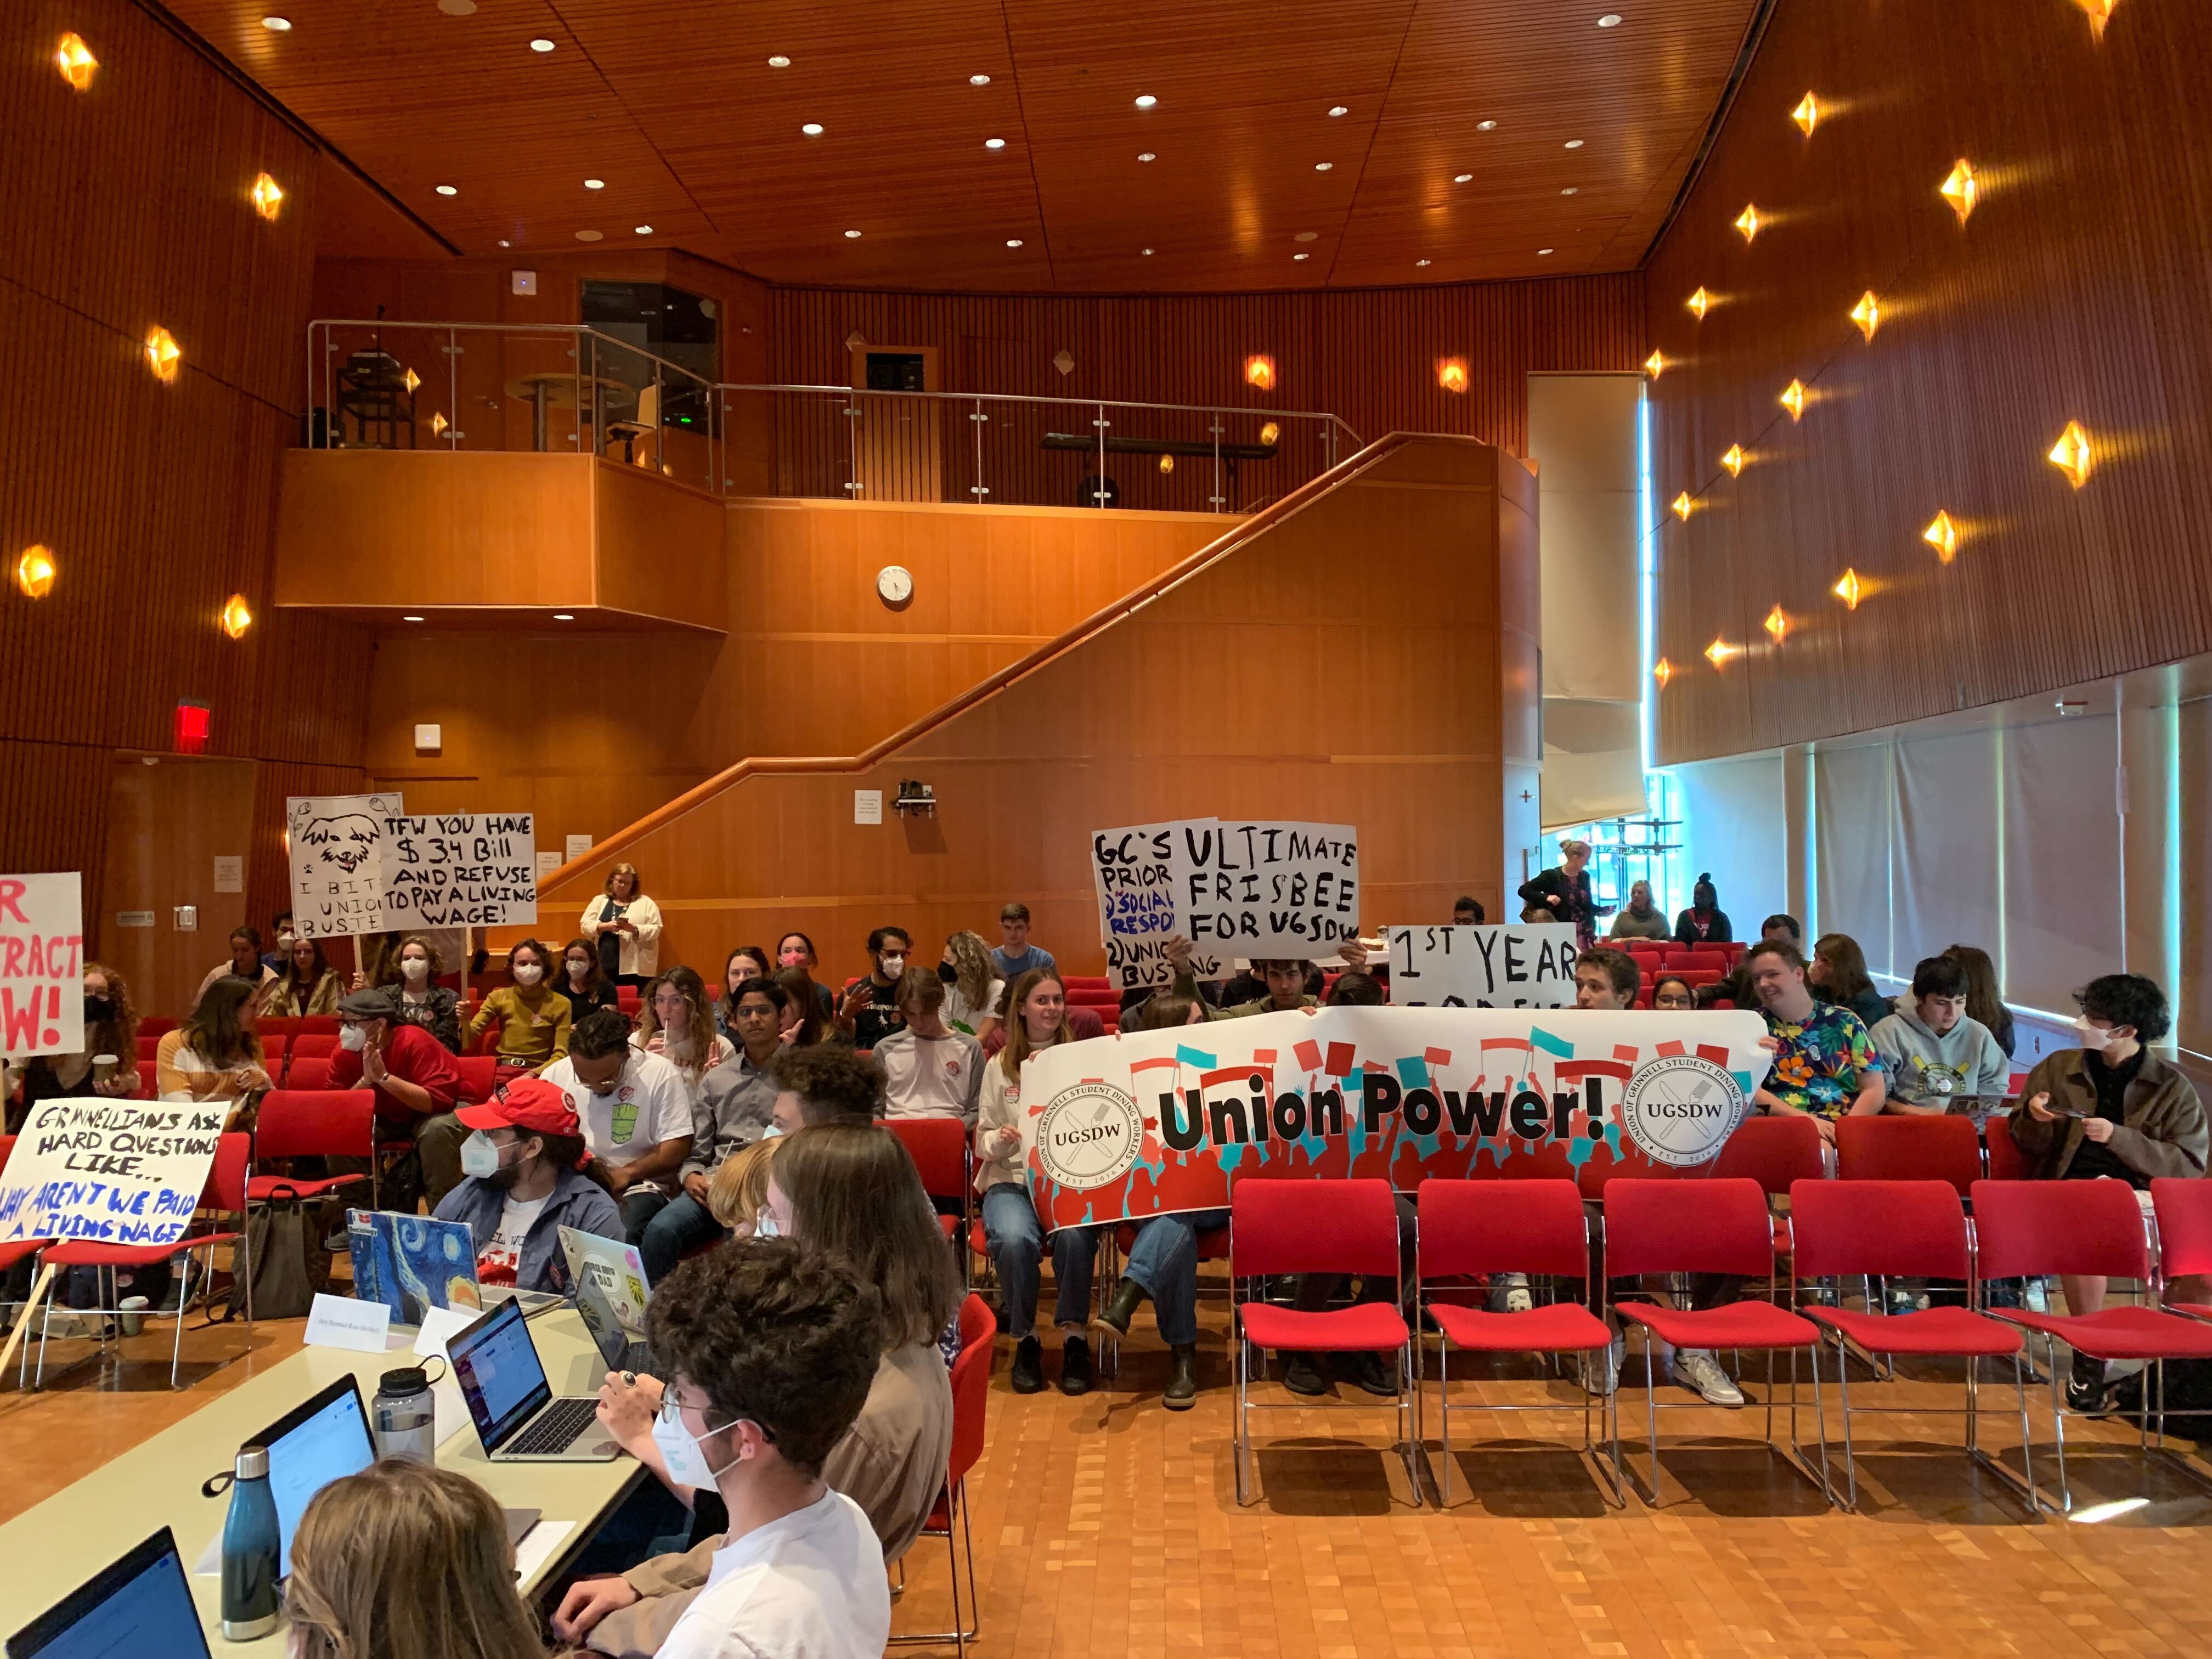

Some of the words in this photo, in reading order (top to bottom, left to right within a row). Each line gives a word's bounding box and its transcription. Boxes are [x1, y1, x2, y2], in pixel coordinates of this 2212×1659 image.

[383, 817, 426, 835] TFW
[436, 816, 474, 835] YOU
[486, 816, 531, 835] HAVE
[473, 836, 511, 862] Bill
[1095, 830, 1172, 865] GC'S
[1185, 826, 1357, 870] ULTIMATE
[299, 882, 312, 895] I
[328, 877, 382, 895] BIT
[393, 868, 448, 885] AND
[453, 866, 532, 884] REFUSE
[385, 889, 409, 910] TO
[411, 886, 443, 909] PAY
[448, 888, 463, 903] A
[467, 885, 536, 903] LIVING
[1189, 871, 1355, 912] FRISBEE
[420, 904, 507, 926] WAGE!
[1110, 911, 1175, 935] RESPO
[1189, 912, 1260, 941] FOR
[0, 934, 83, 979] RACT
[1474, 930, 1577, 994] YEAR
[0, 985, 60, 1052] W!
[1666, 1059, 1714, 1071] STUDENT
[1070, 1086, 1111, 1097] STUDENT
[1628, 1063, 1664, 1098] GRINNELL
[1714, 1069, 1741, 1099] DINING
[1041, 1095, 1069, 1132] GRINNELL
[1111, 1091, 1136, 1116] DINING
[1159, 1073, 1343, 1152] Union
[1362, 1074, 1604, 1141] Power!
[1626, 1099, 1634, 1111] OF
[1647, 1103, 1724, 1118] UGSDW
[186, 1111, 221, 1131] ASK
[1627, 1114, 1646, 1143] UNION
[36, 1131, 102, 1156] HARD
[110, 1132, 219, 1156] QUESTIONS
[1039, 1136, 1045, 1146] OF
[1054, 1123, 1121, 1147] UGSDW
[1125, 1118, 1141, 1161] WORKERS
[64, 1152, 163, 1182] LIKE...
[1040, 1148, 1054, 1173] UNION
[1658, 1151, 1678, 1163] EST
[108, 1188, 150, 1216] WE
[152, 1188, 196, 1217] PAID
[5, 1221, 24, 1240] A
[31, 1213, 114, 1239] LIVING
[118, 1219, 185, 1244] WAGE
